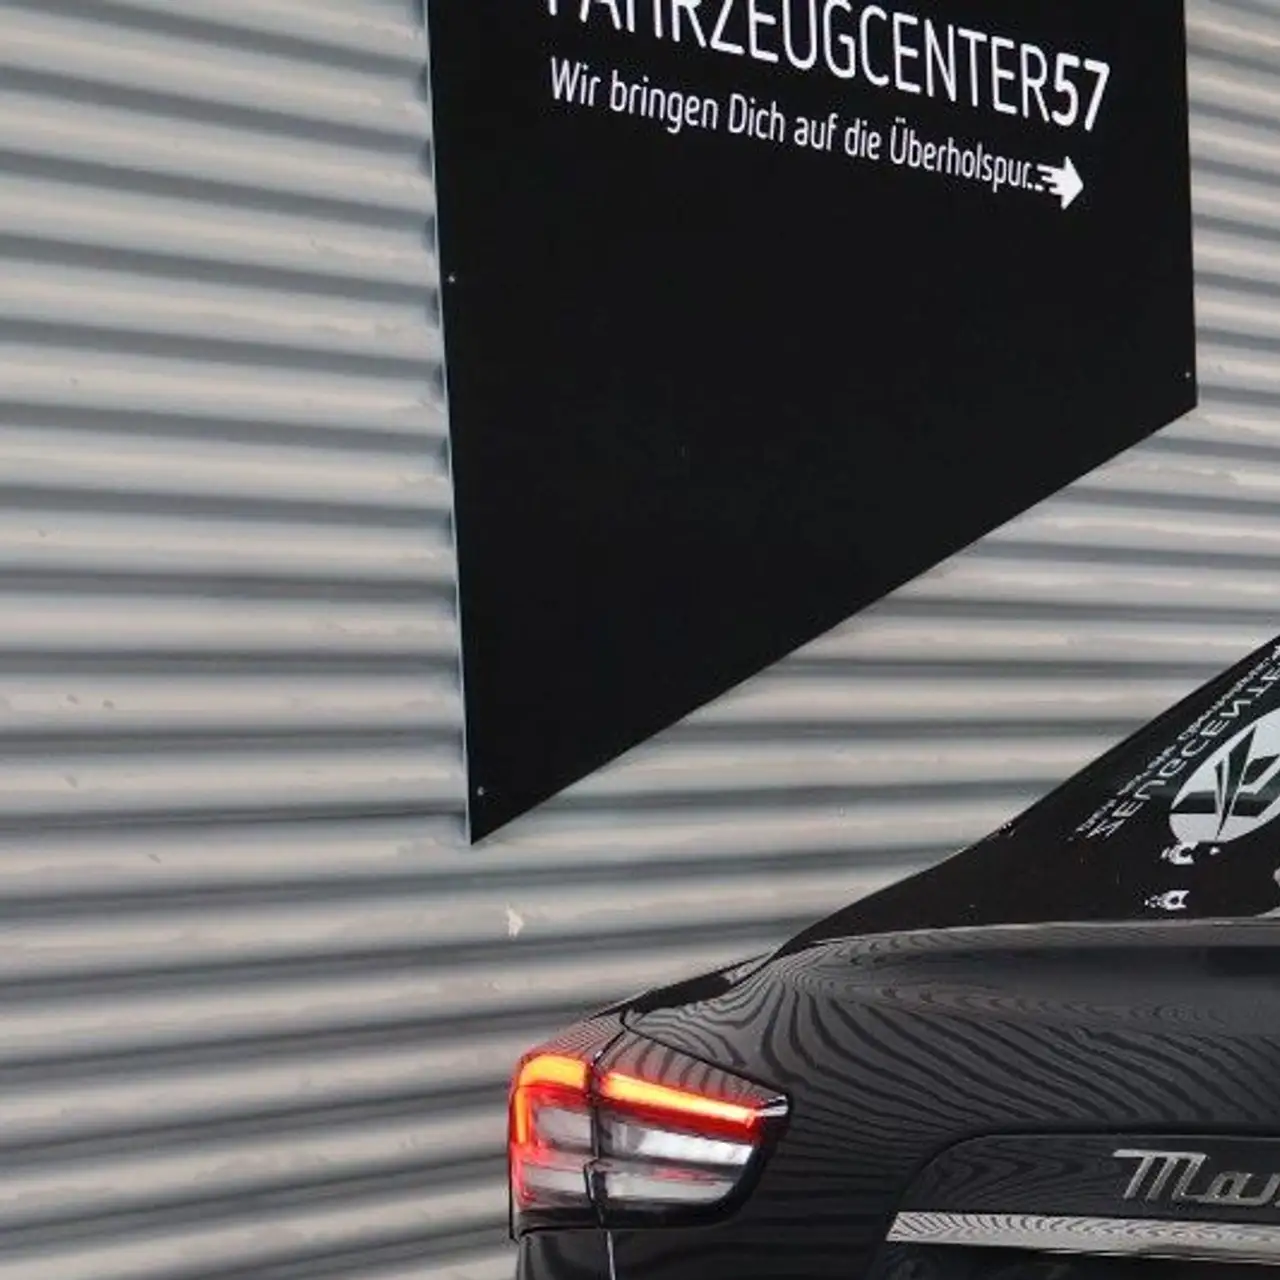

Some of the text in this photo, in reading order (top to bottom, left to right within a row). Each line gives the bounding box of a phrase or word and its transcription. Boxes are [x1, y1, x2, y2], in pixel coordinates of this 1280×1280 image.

[549, 0, 1110, 131] RZEUGCENTER57
[550, 56, 601, 107] Wir
[609, 69, 719, 134] bringen
[728, 93, 785, 143] Dich
[794, 112, 838, 151] auf
[844, 117, 882, 160] die
